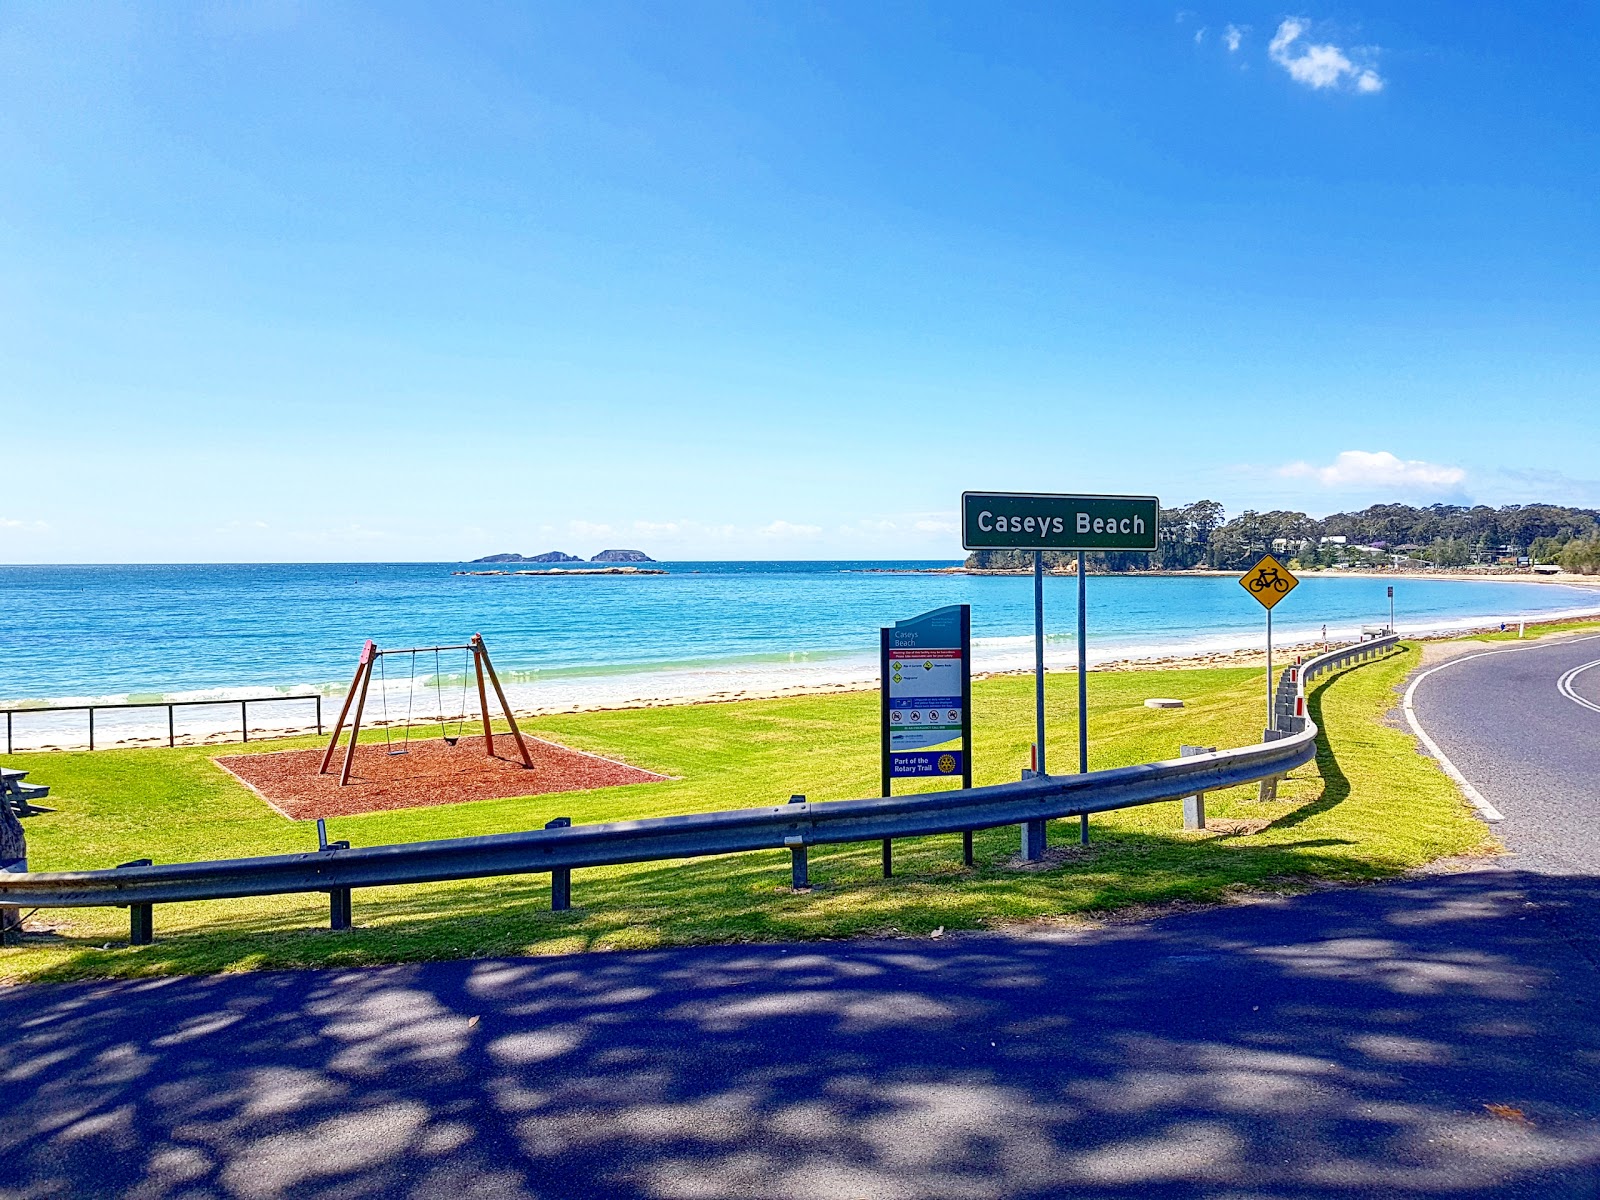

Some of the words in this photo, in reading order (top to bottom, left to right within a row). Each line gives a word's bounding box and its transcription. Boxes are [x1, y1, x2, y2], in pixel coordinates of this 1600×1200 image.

[977, 510, 1064, 538] Caseys
[1076, 512, 1145, 534] Beach
[894, 630, 919, 639] Caseys
[895, 639, 916, 647] Beach
[894, 765, 917, 773] Rotary
